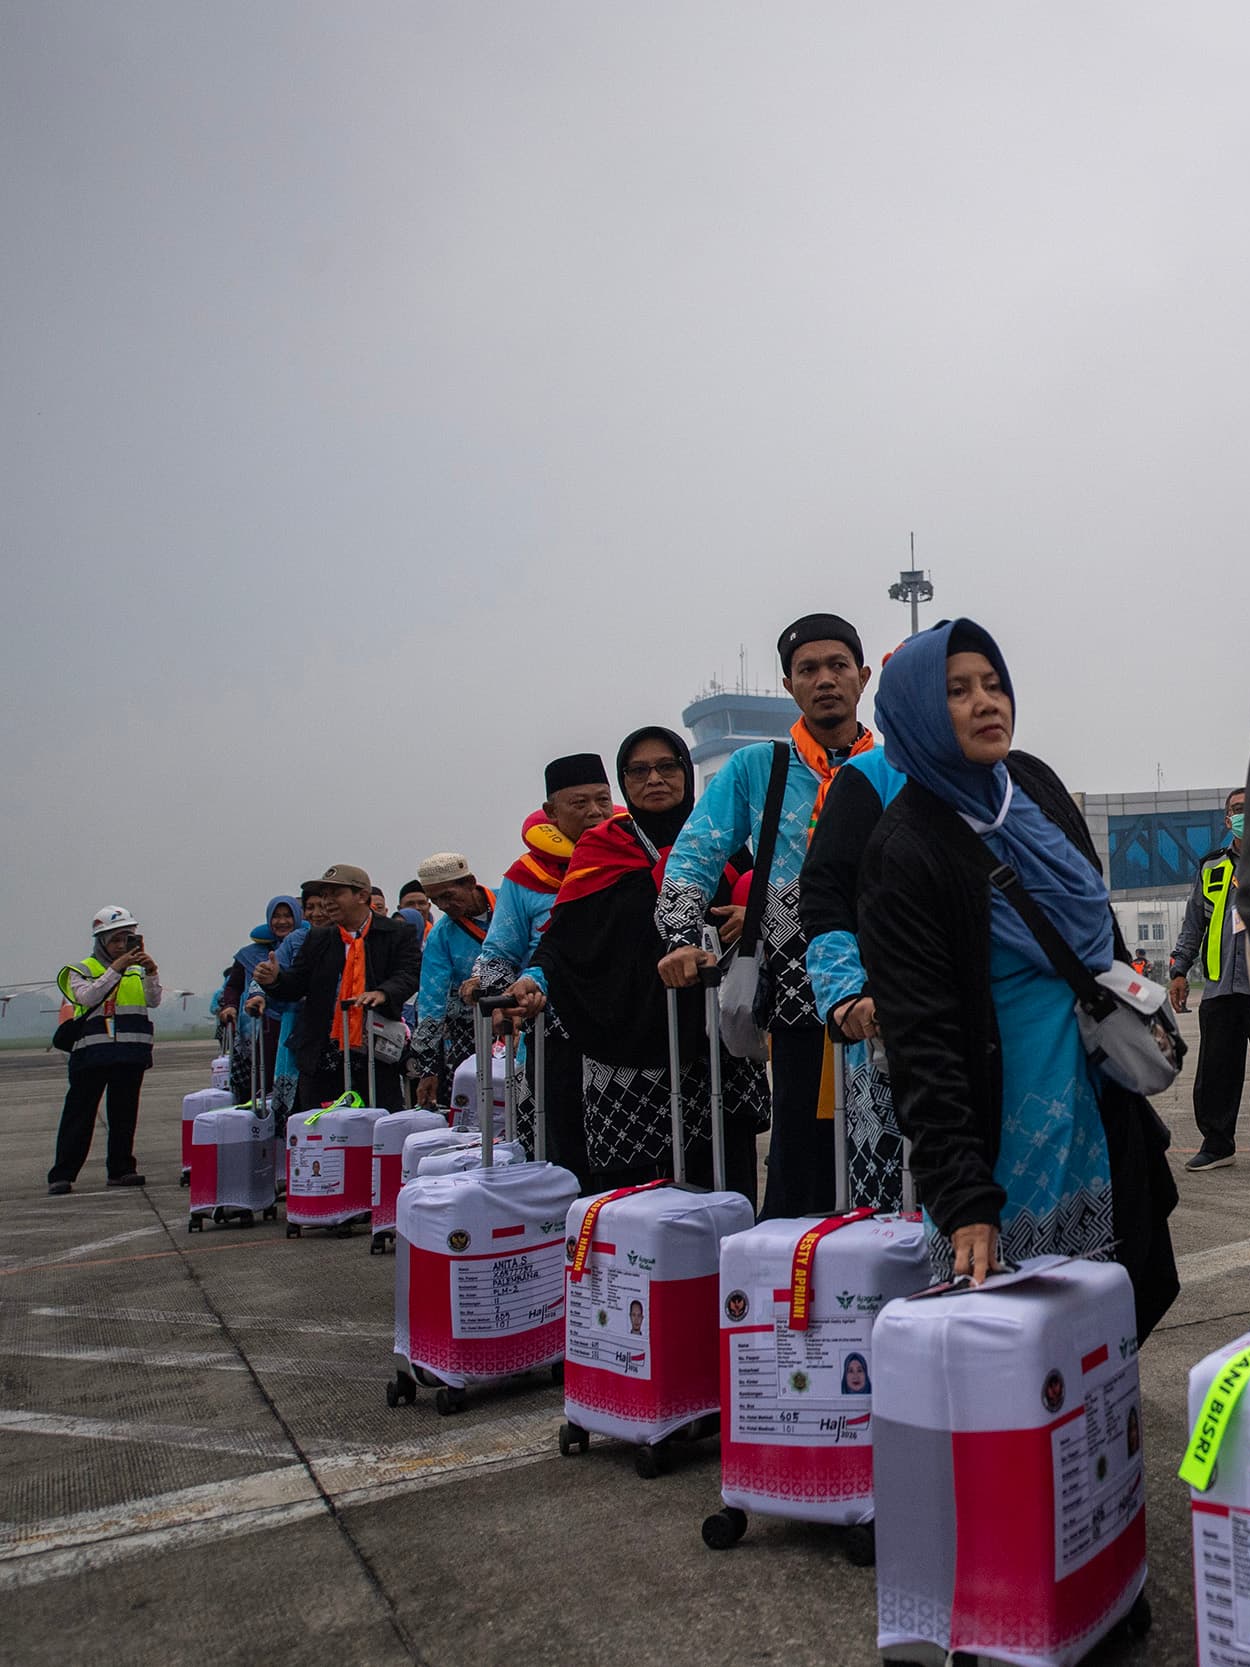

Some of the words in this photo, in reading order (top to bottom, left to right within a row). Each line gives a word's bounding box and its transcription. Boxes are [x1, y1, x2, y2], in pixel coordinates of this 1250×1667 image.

[574, 1237, 588, 1271] HAKIM
[797, 1232, 820, 1265] DESTY
[793, 1269, 807, 1318] APRIANI
[820, 1416, 846, 1443] Haji
[1194, 1399, 1225, 1463] BISRI
